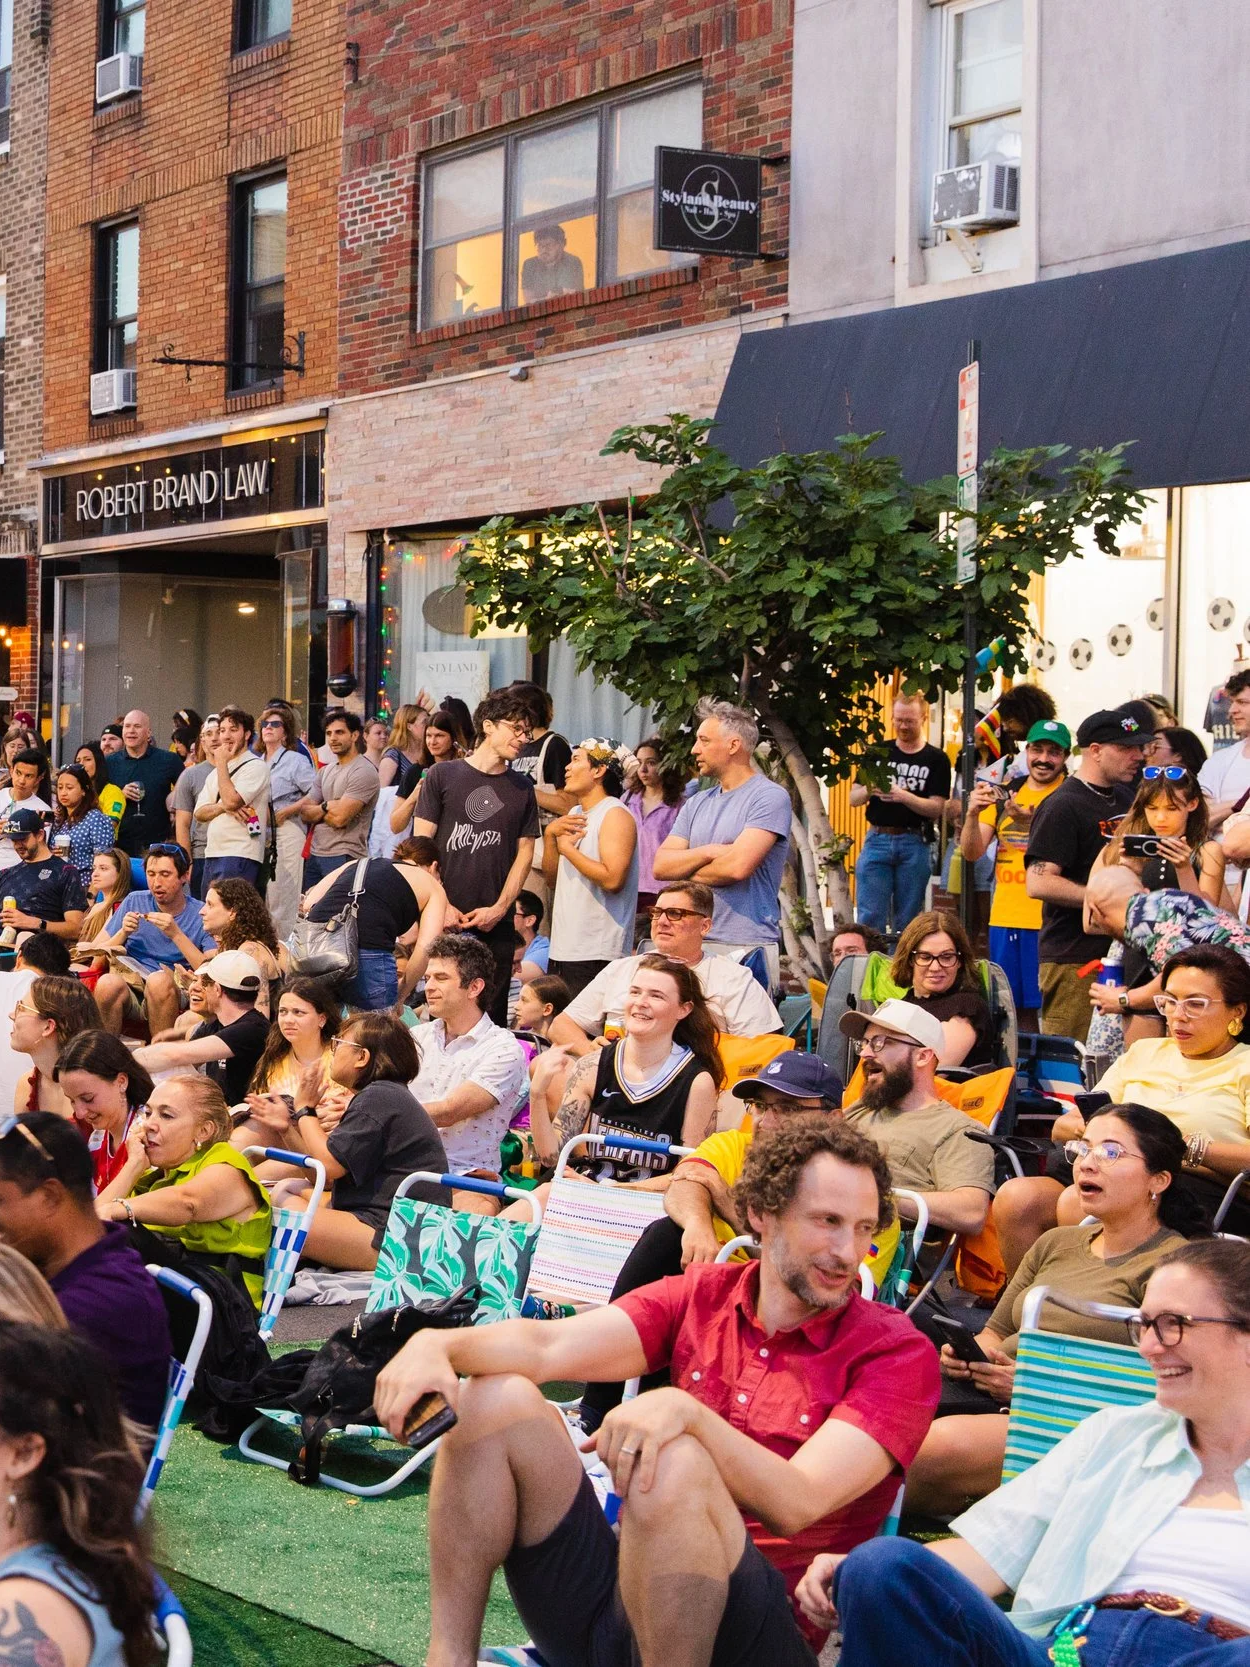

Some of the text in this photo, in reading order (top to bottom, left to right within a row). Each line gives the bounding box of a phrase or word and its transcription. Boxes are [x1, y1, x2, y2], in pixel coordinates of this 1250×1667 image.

[713, 195, 759, 214] Beauty
[76, 459, 267, 521] ROBERT BRAND LAW
[428, 663, 478, 673] STYLAND
